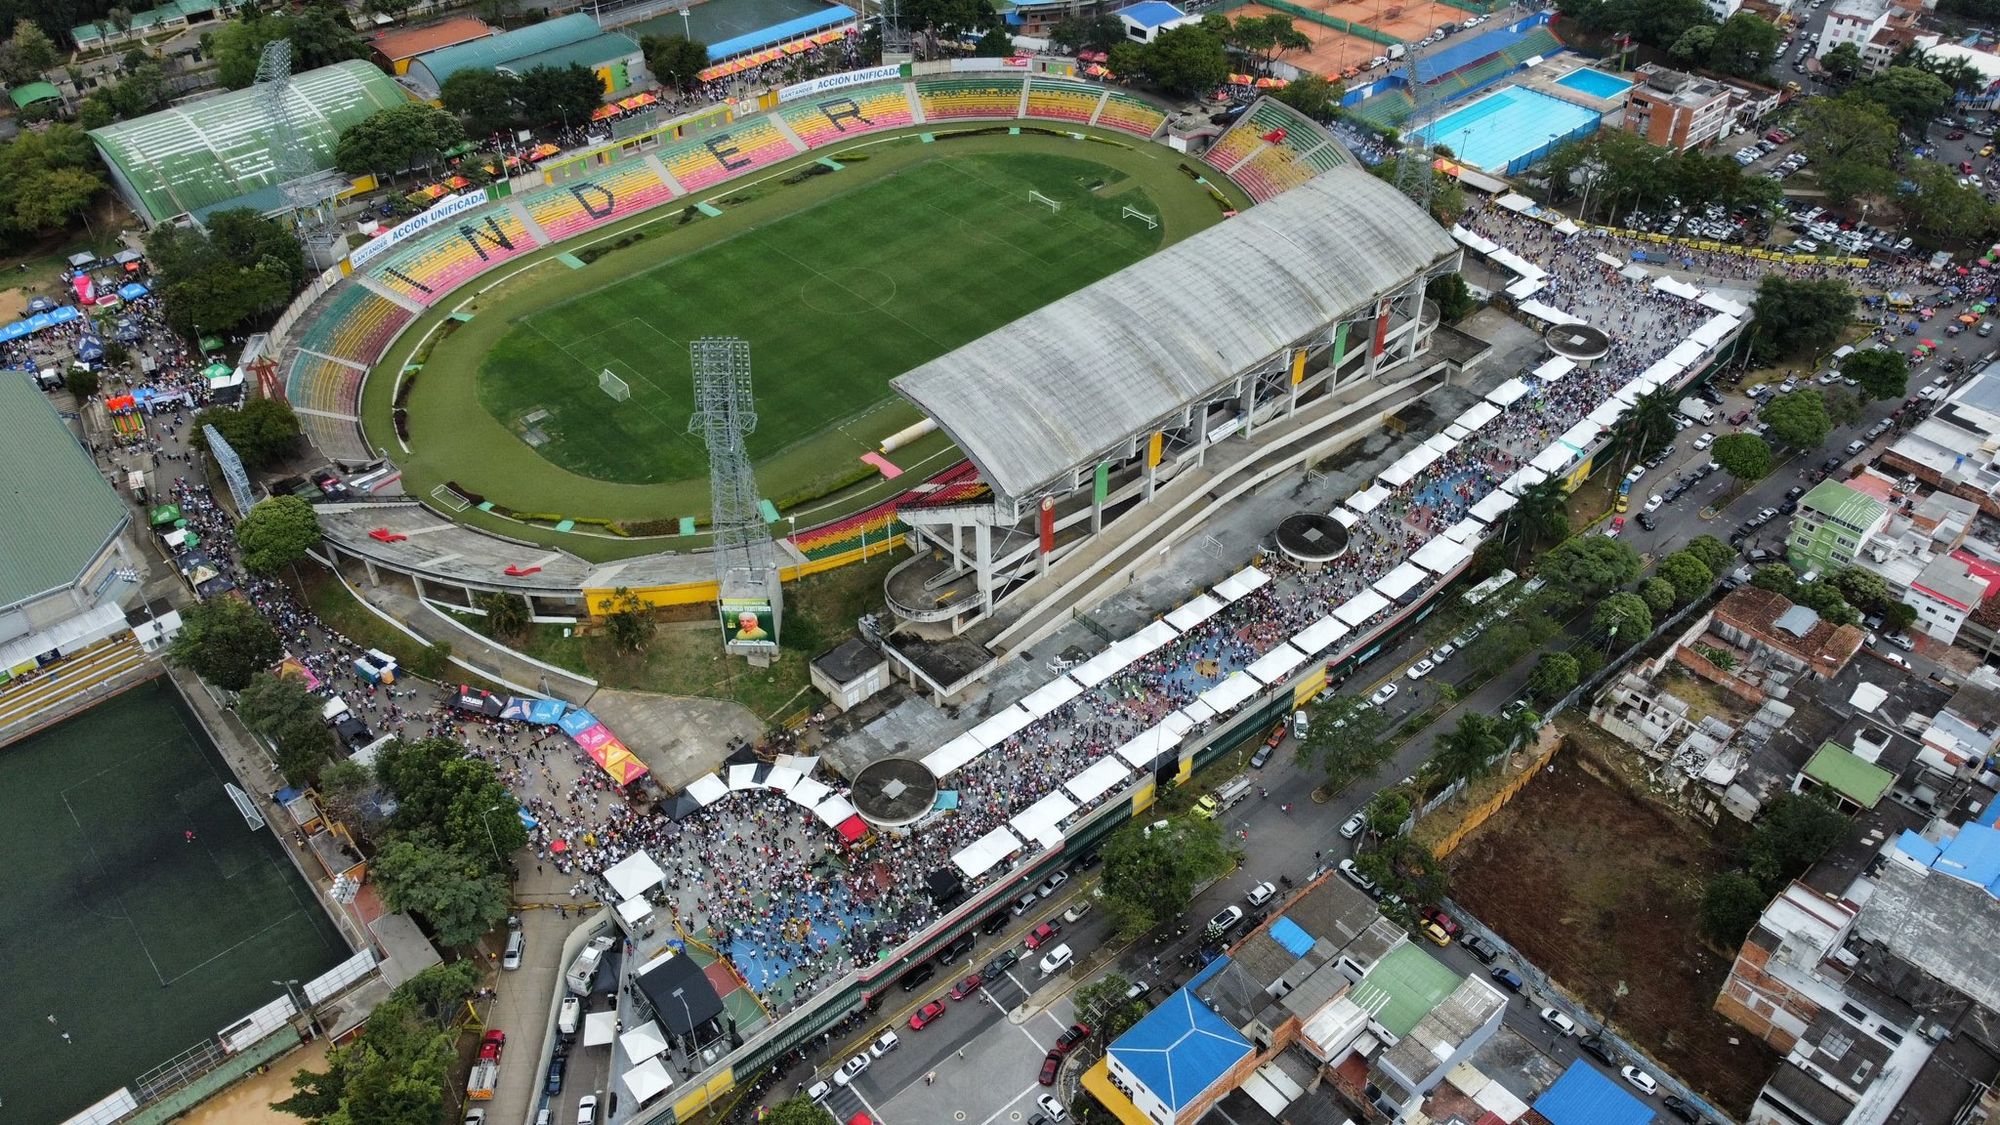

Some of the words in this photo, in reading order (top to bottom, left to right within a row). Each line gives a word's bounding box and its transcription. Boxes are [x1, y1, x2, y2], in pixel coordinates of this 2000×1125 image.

[854, 67, 900, 82] UNIFICADA
[353, 239, 388, 264] SANTANDER
[431, 192, 485, 221] UNIFICADA
